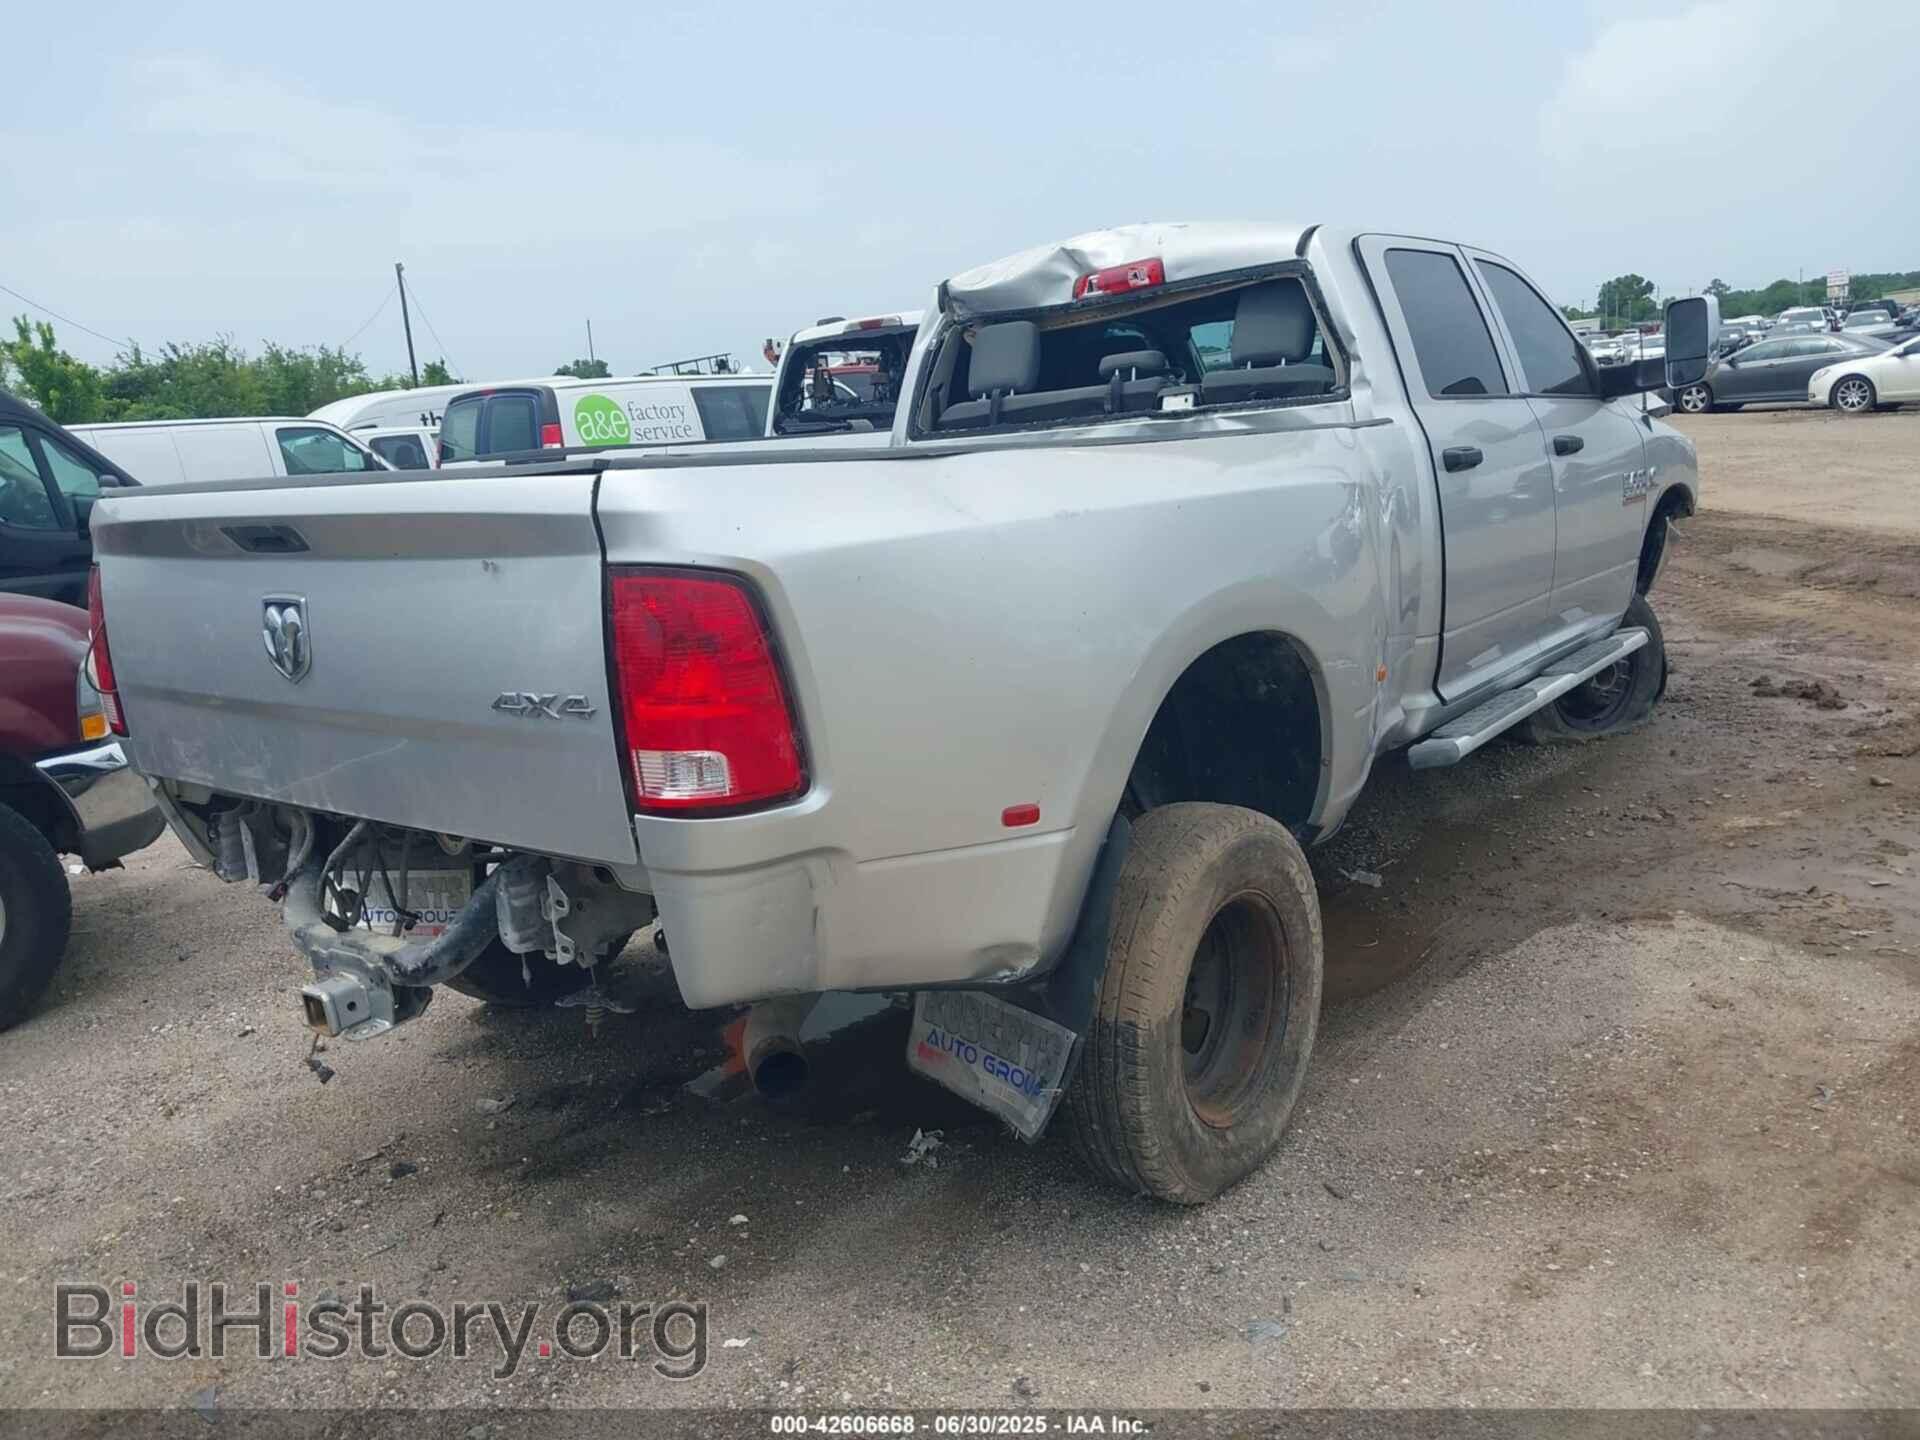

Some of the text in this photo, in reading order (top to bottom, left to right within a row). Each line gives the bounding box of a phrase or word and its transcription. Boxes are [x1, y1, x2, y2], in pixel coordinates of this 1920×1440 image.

[627, 401, 686, 423] factory
[577, 409, 629, 441] a&e
[634, 419, 692, 441] service
[361, 910, 397, 923] UTO
[927, 1029, 978, 1065] AUTO
